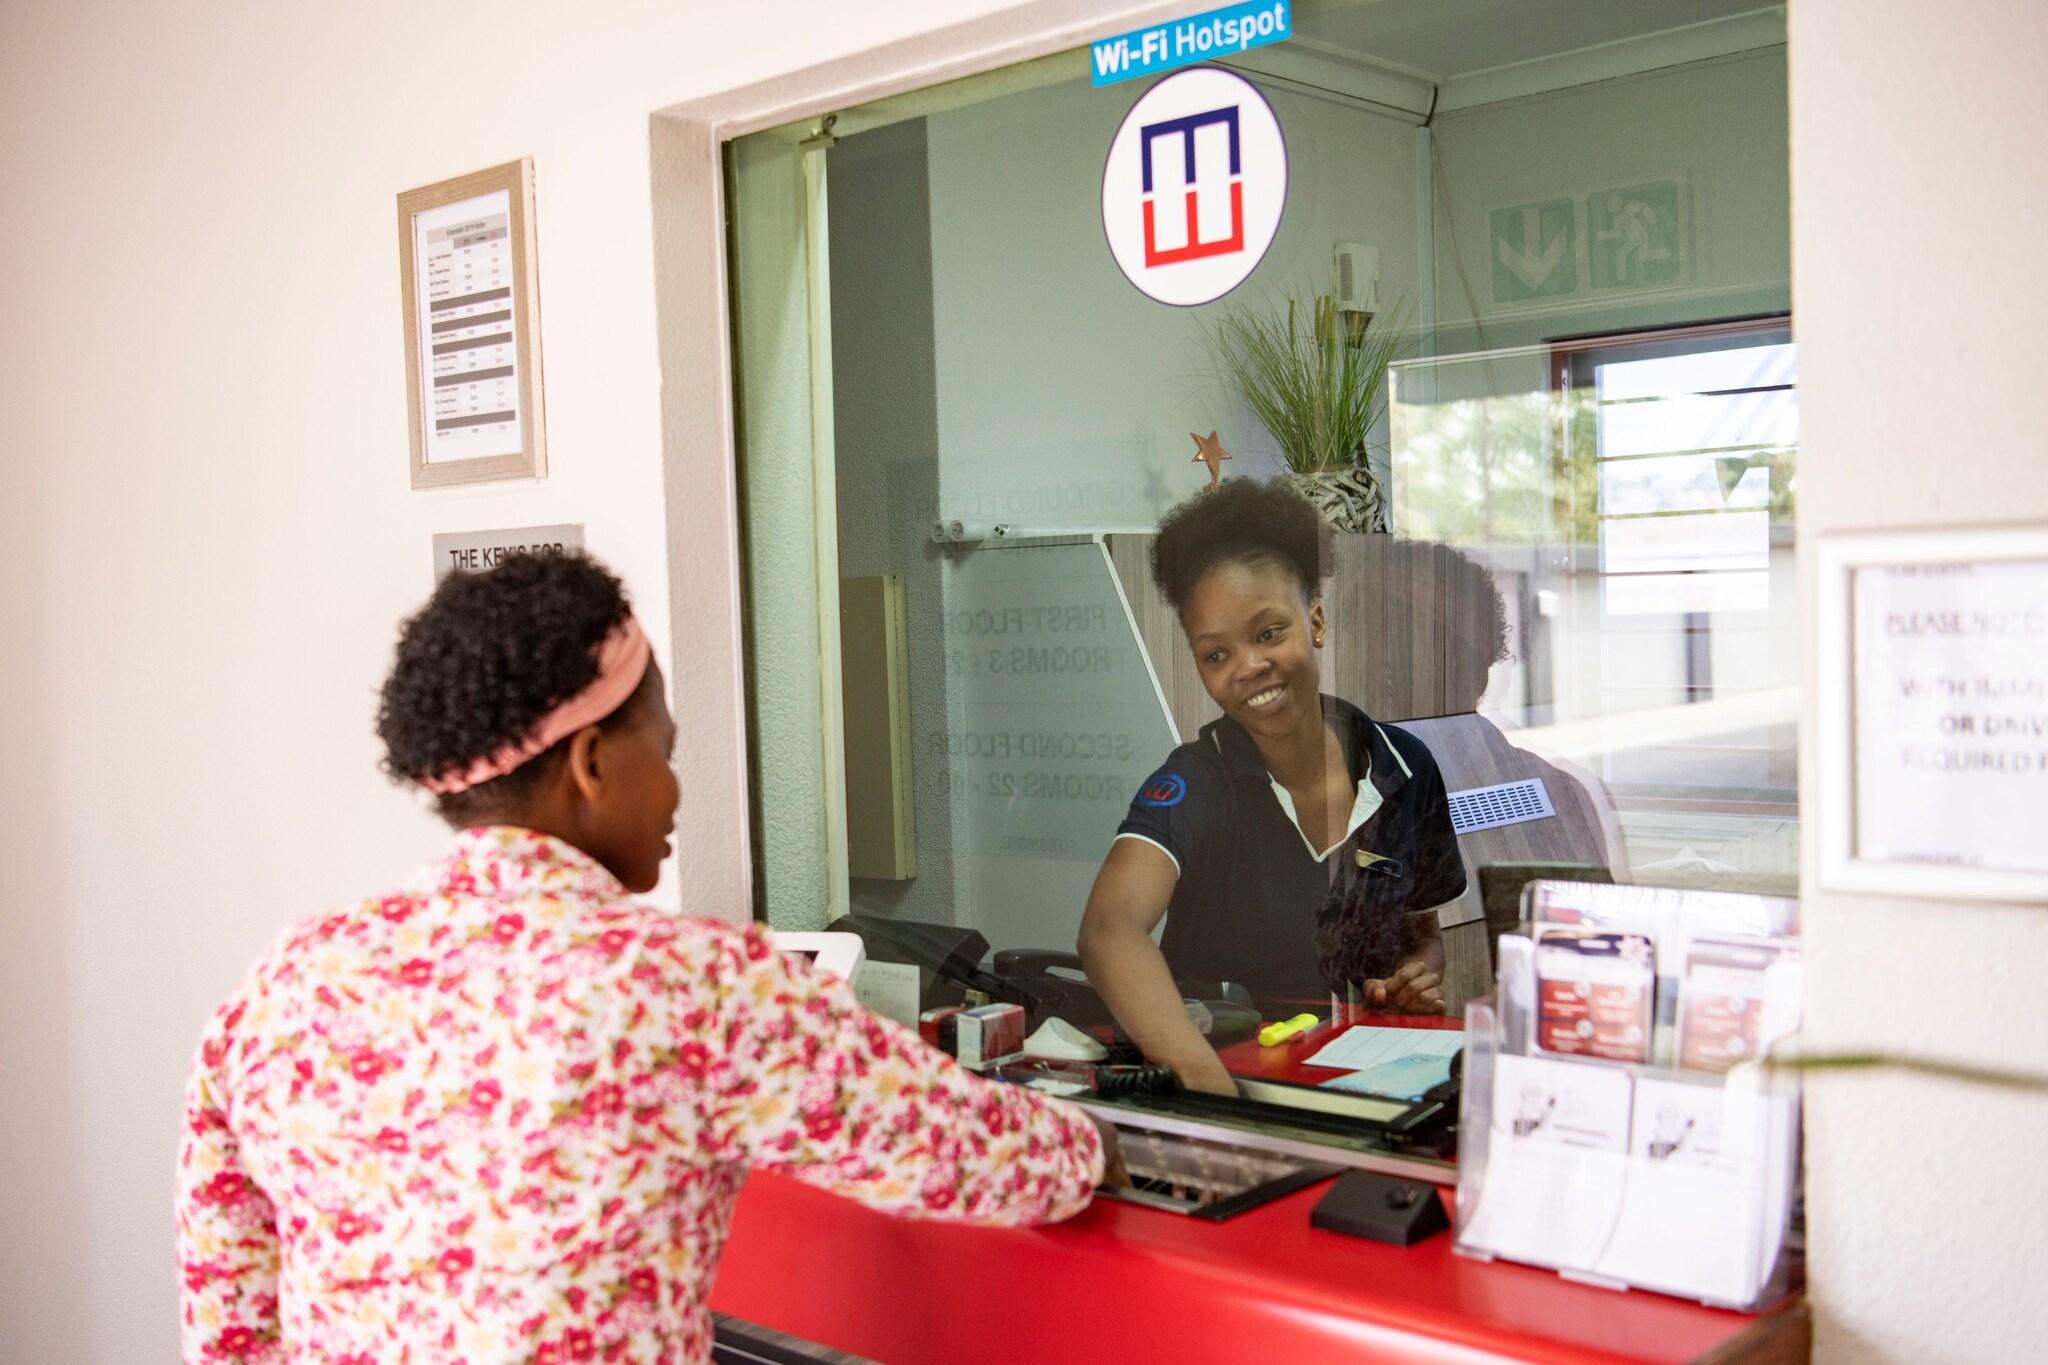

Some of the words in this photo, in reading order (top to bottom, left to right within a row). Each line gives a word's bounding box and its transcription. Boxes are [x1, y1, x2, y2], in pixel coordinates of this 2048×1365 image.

[1094, 29, 1168, 76] Wi-Fi
[1175, 2, 1286, 57] Hotspot
[449, 548, 479, 569] THE
[1938, 713, 1977, 737] OR
